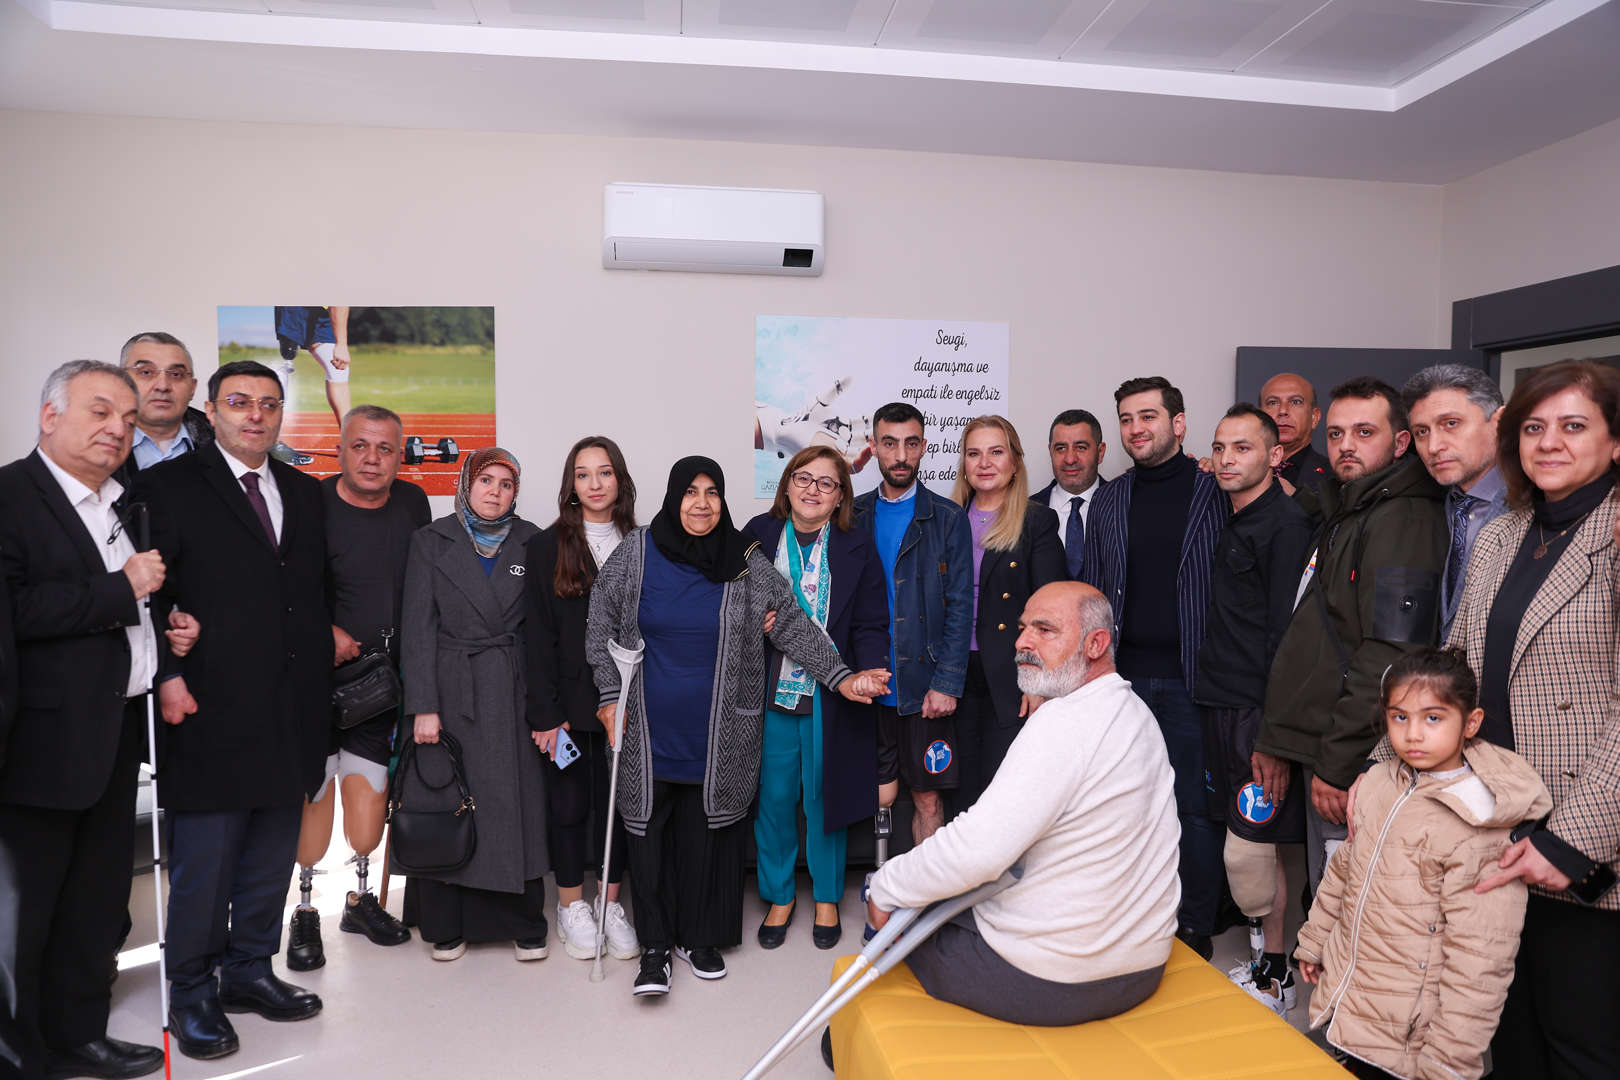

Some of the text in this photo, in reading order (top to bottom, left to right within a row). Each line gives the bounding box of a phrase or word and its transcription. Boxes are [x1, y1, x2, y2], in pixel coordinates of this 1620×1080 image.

[935, 329, 968, 351] Sevgi,
[913, 356, 989, 378] dayanışma ve
[901, 384, 1000, 406] empati ile engelsiz
